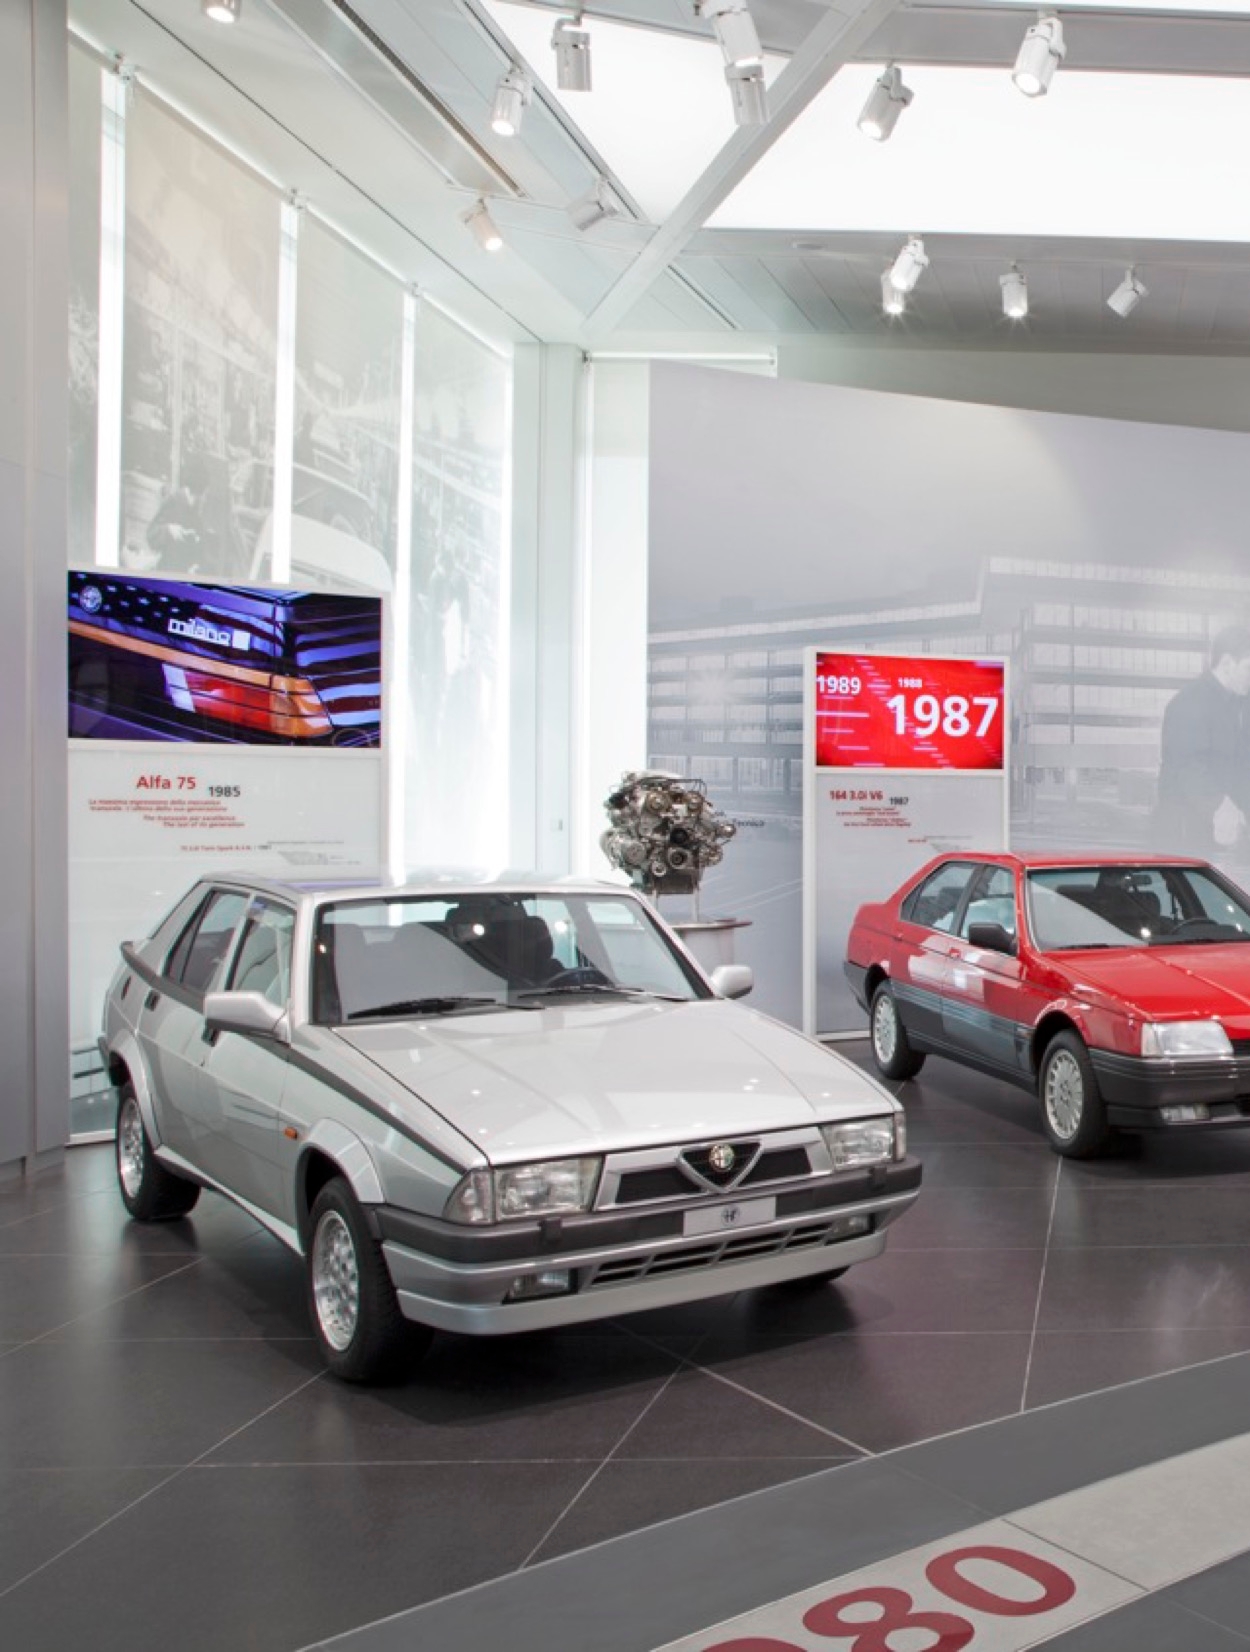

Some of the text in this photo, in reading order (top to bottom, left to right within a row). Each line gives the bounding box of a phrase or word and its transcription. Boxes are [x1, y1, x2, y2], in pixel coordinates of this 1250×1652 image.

[167, 618, 231, 647] milano
[816, 674, 861, 696] 1989
[886, 694, 999, 738] 1987
[136, 775, 241, 798] Alfa 75 1985
[829, 790, 847, 800] 164
[869, 791, 884, 801] V6
